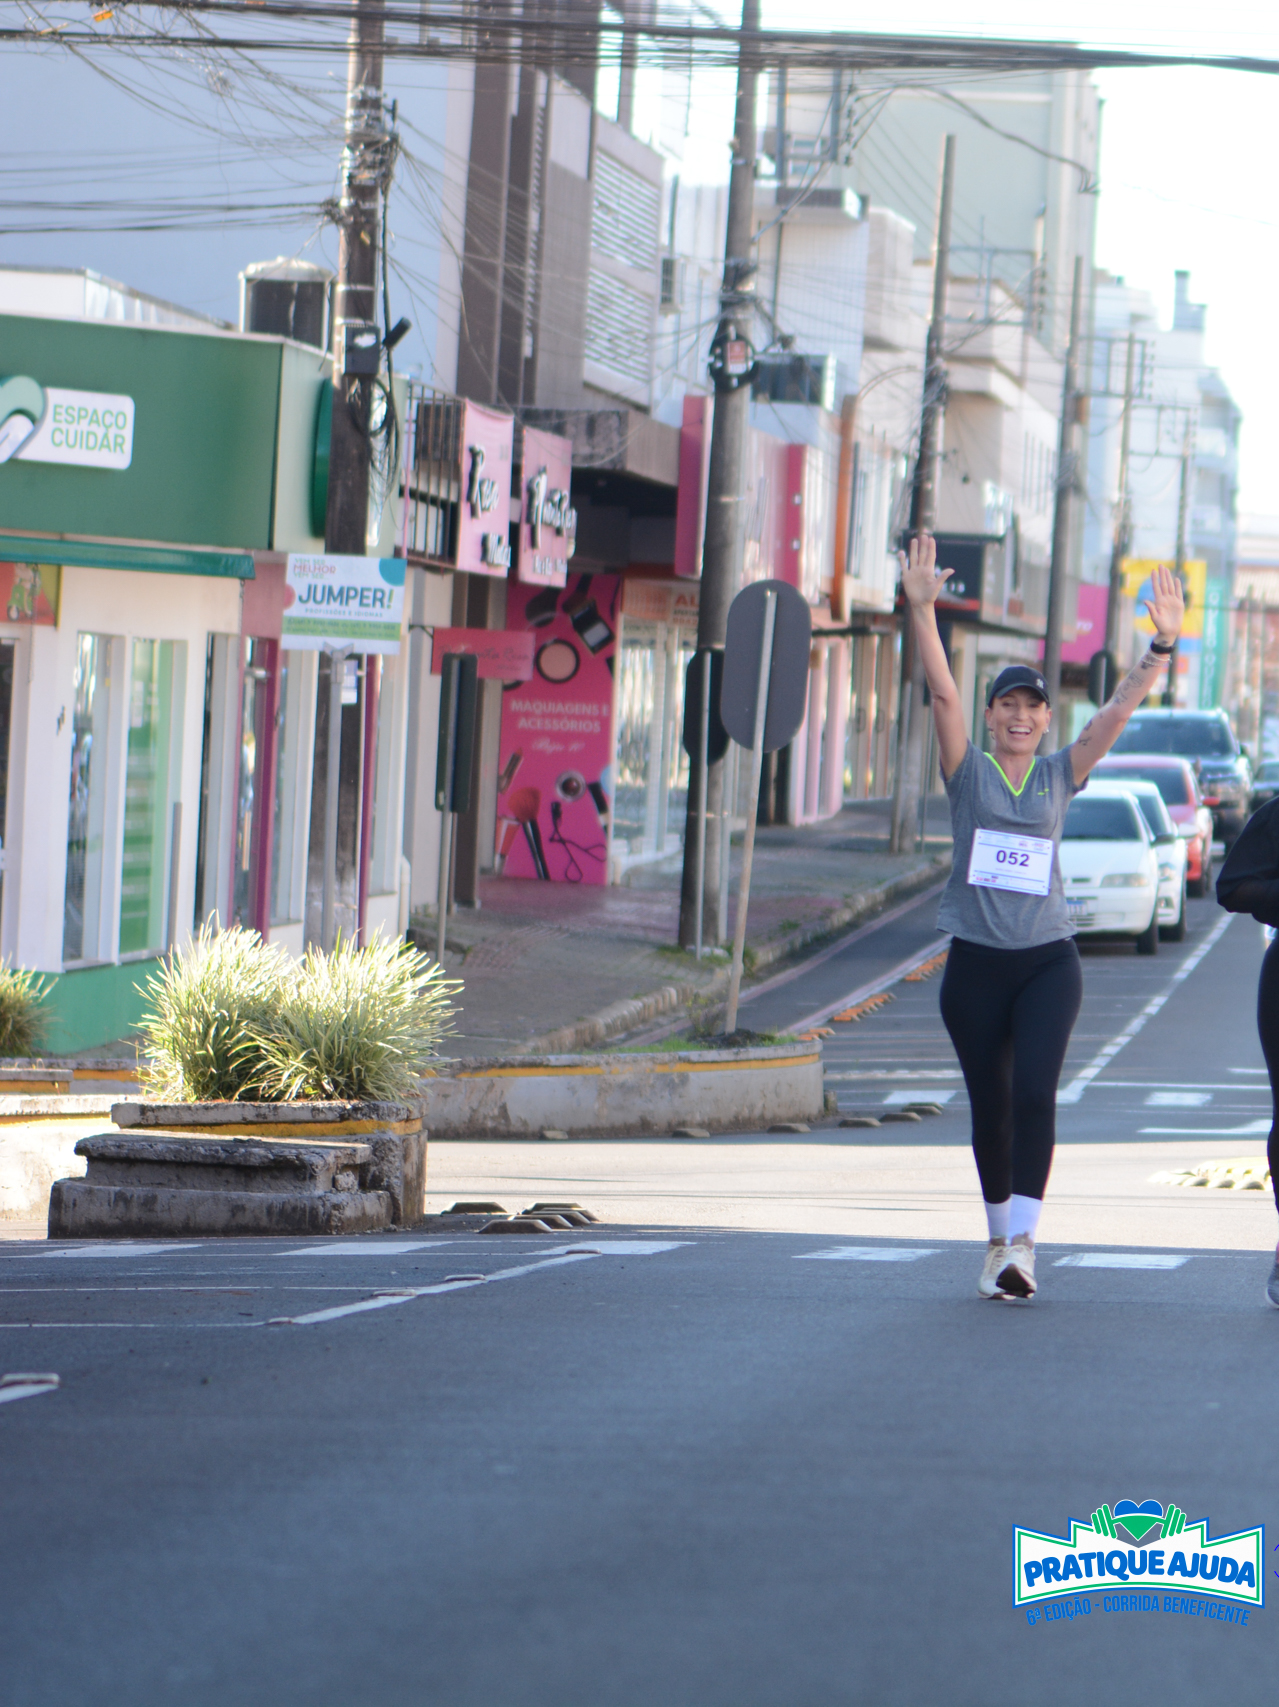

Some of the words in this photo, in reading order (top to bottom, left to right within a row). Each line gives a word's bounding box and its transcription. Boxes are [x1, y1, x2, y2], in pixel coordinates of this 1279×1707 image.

[53, 404, 128, 432] ESPAÇO
[51, 427, 126, 454] CUIDAR
[293, 563, 337, 575] MELHOR
[298, 583, 395, 610] JUMPER!
[354, 610, 384, 619] IDIOMAS
[511, 699, 600, 717] MAQUIAGENS
[602, 703, 611, 717] E
[518, 716, 602, 734] ACESSÓRIOS
[996, 849, 1030, 867] 052
